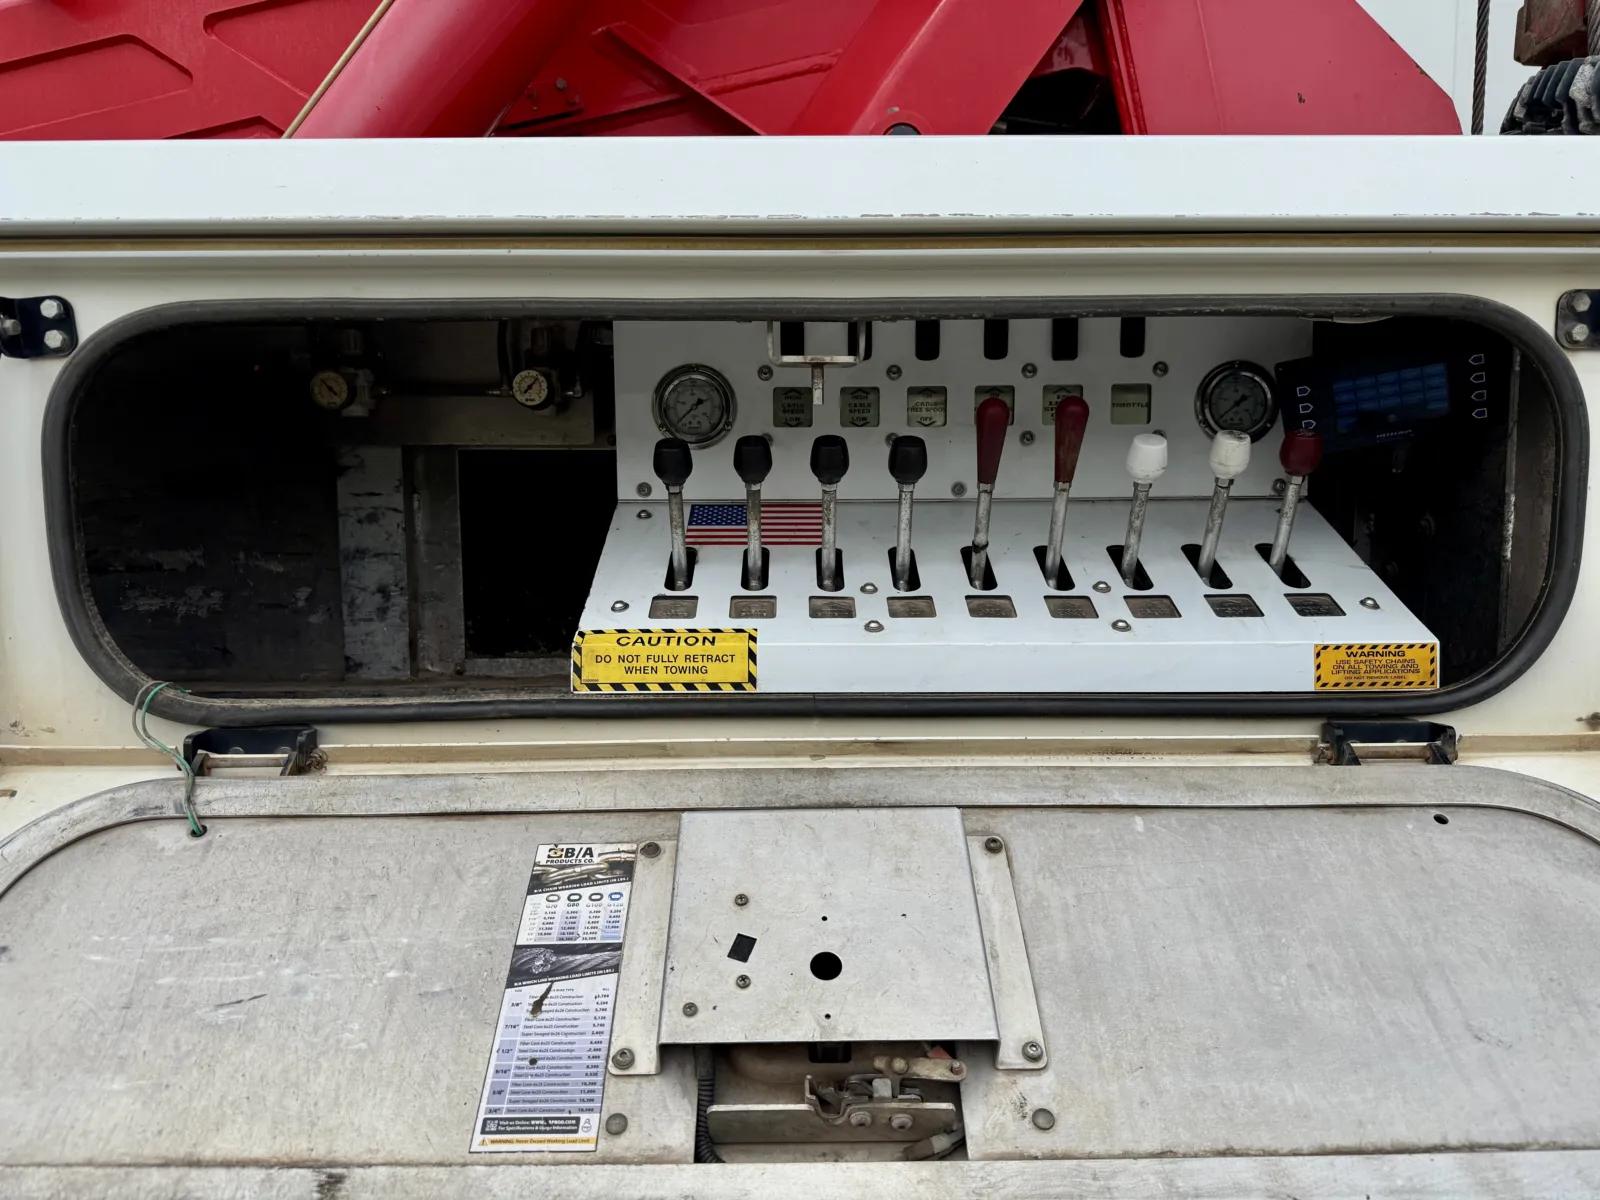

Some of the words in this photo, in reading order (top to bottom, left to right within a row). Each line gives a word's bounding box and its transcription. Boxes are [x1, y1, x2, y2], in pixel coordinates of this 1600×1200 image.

[616, 635, 716, 647] CAUTION
[596, 654, 612, 663] DO
[618, 654, 641, 663] NOT
[647, 654, 679, 663] FULLY
[685, 654, 736, 663] RETRACT
[624, 666, 658, 674] WHEN
[664, 666, 708, 674] TOWING
[564, 847, 594, 859] B/A
